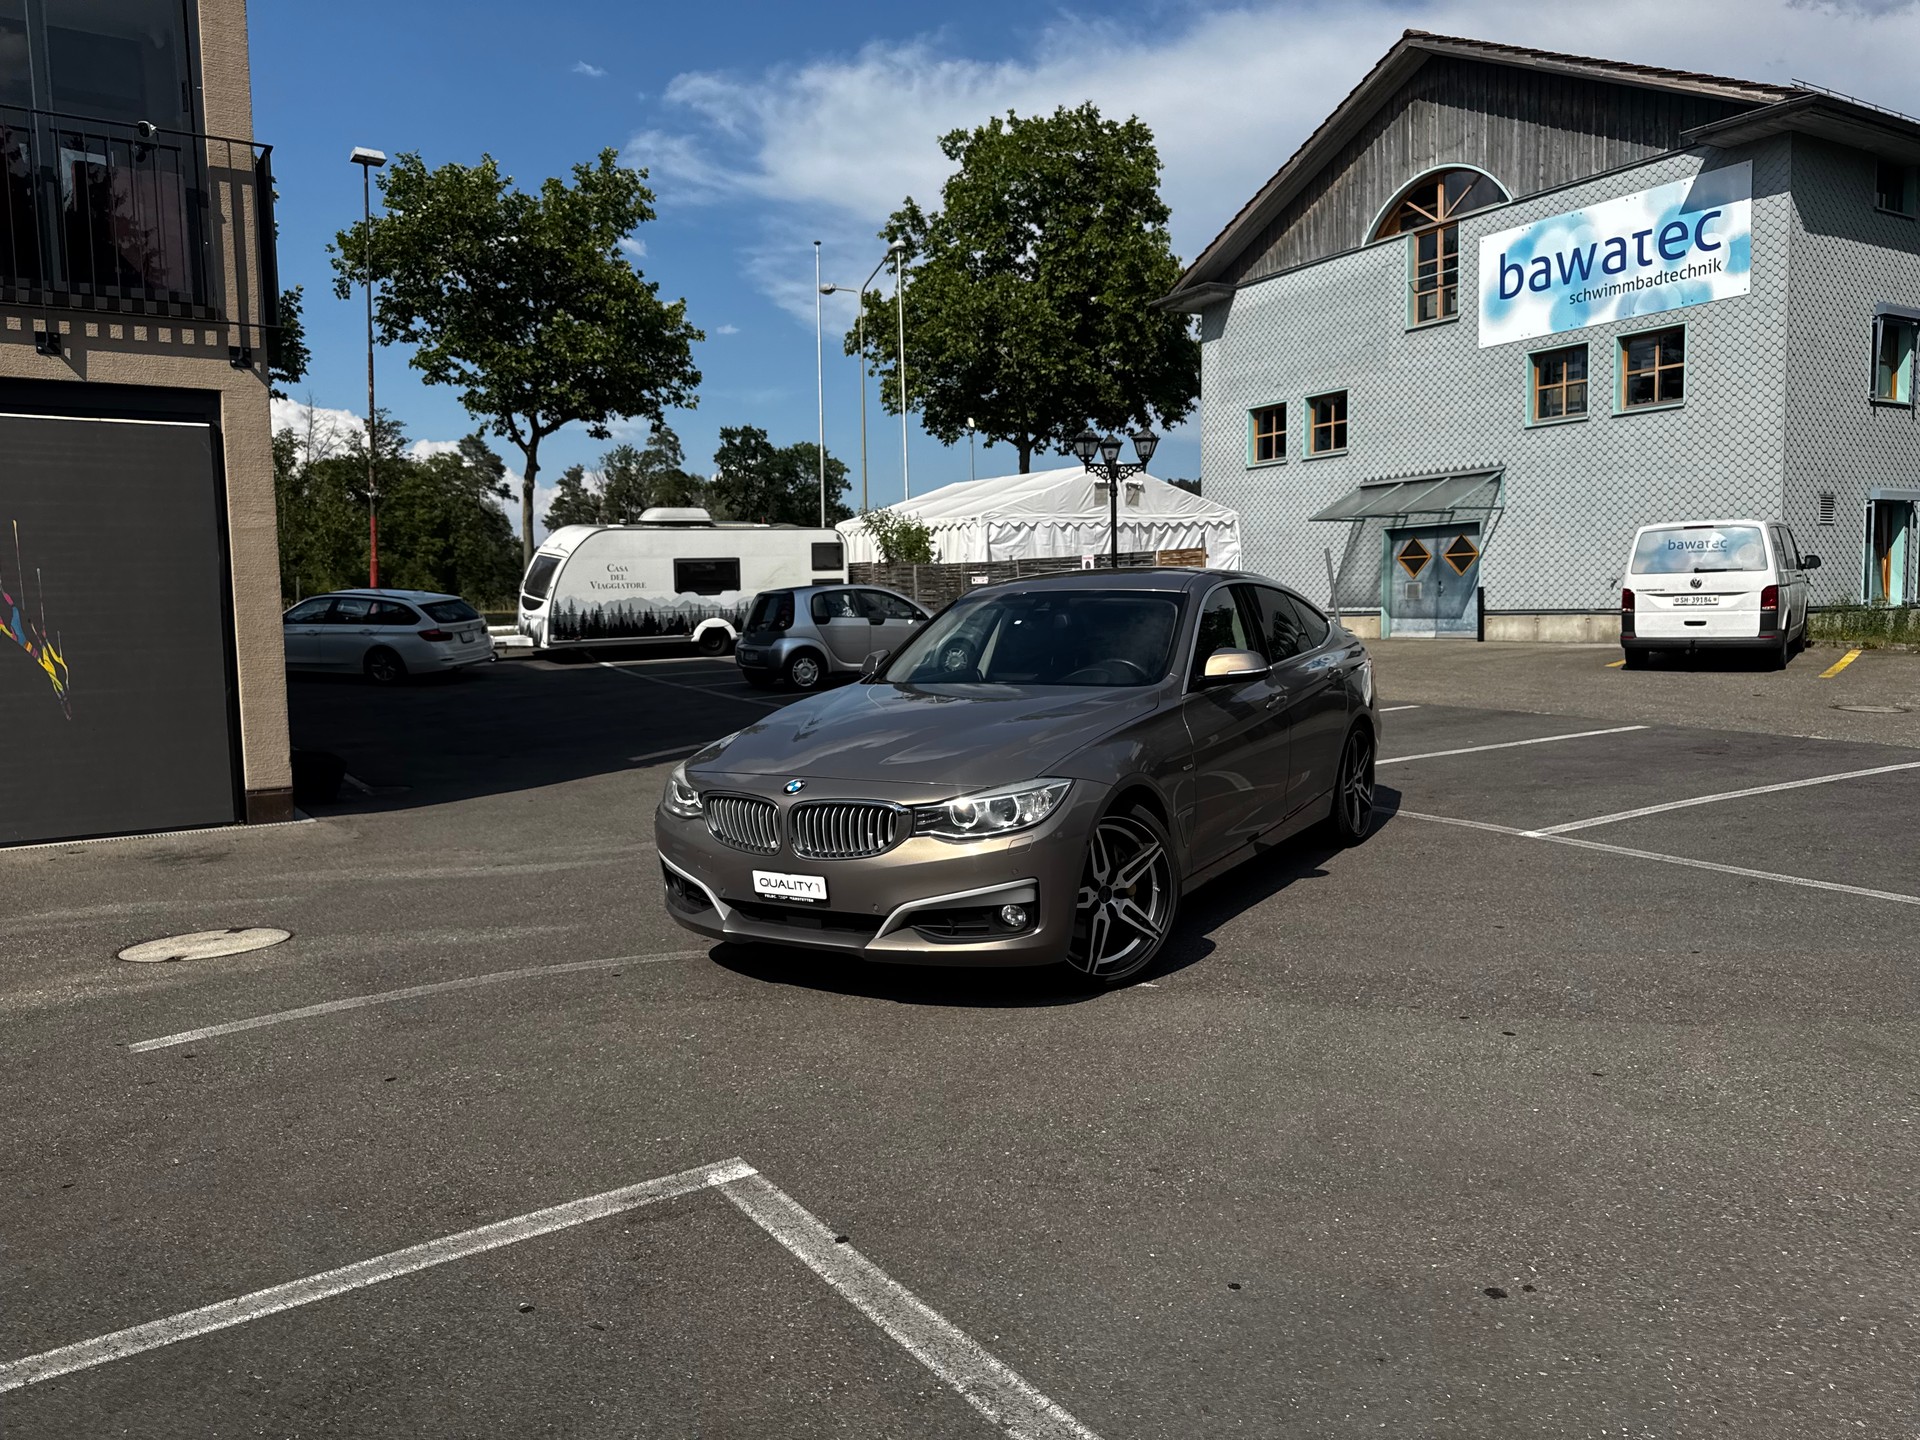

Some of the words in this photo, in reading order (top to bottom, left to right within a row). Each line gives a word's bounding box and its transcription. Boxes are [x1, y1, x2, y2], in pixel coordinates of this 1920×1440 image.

[1498, 210, 1722, 300] bawatec
[1569, 258, 1722, 305] schwimmbadtechnik
[1668, 539, 1728, 550] bawatec
